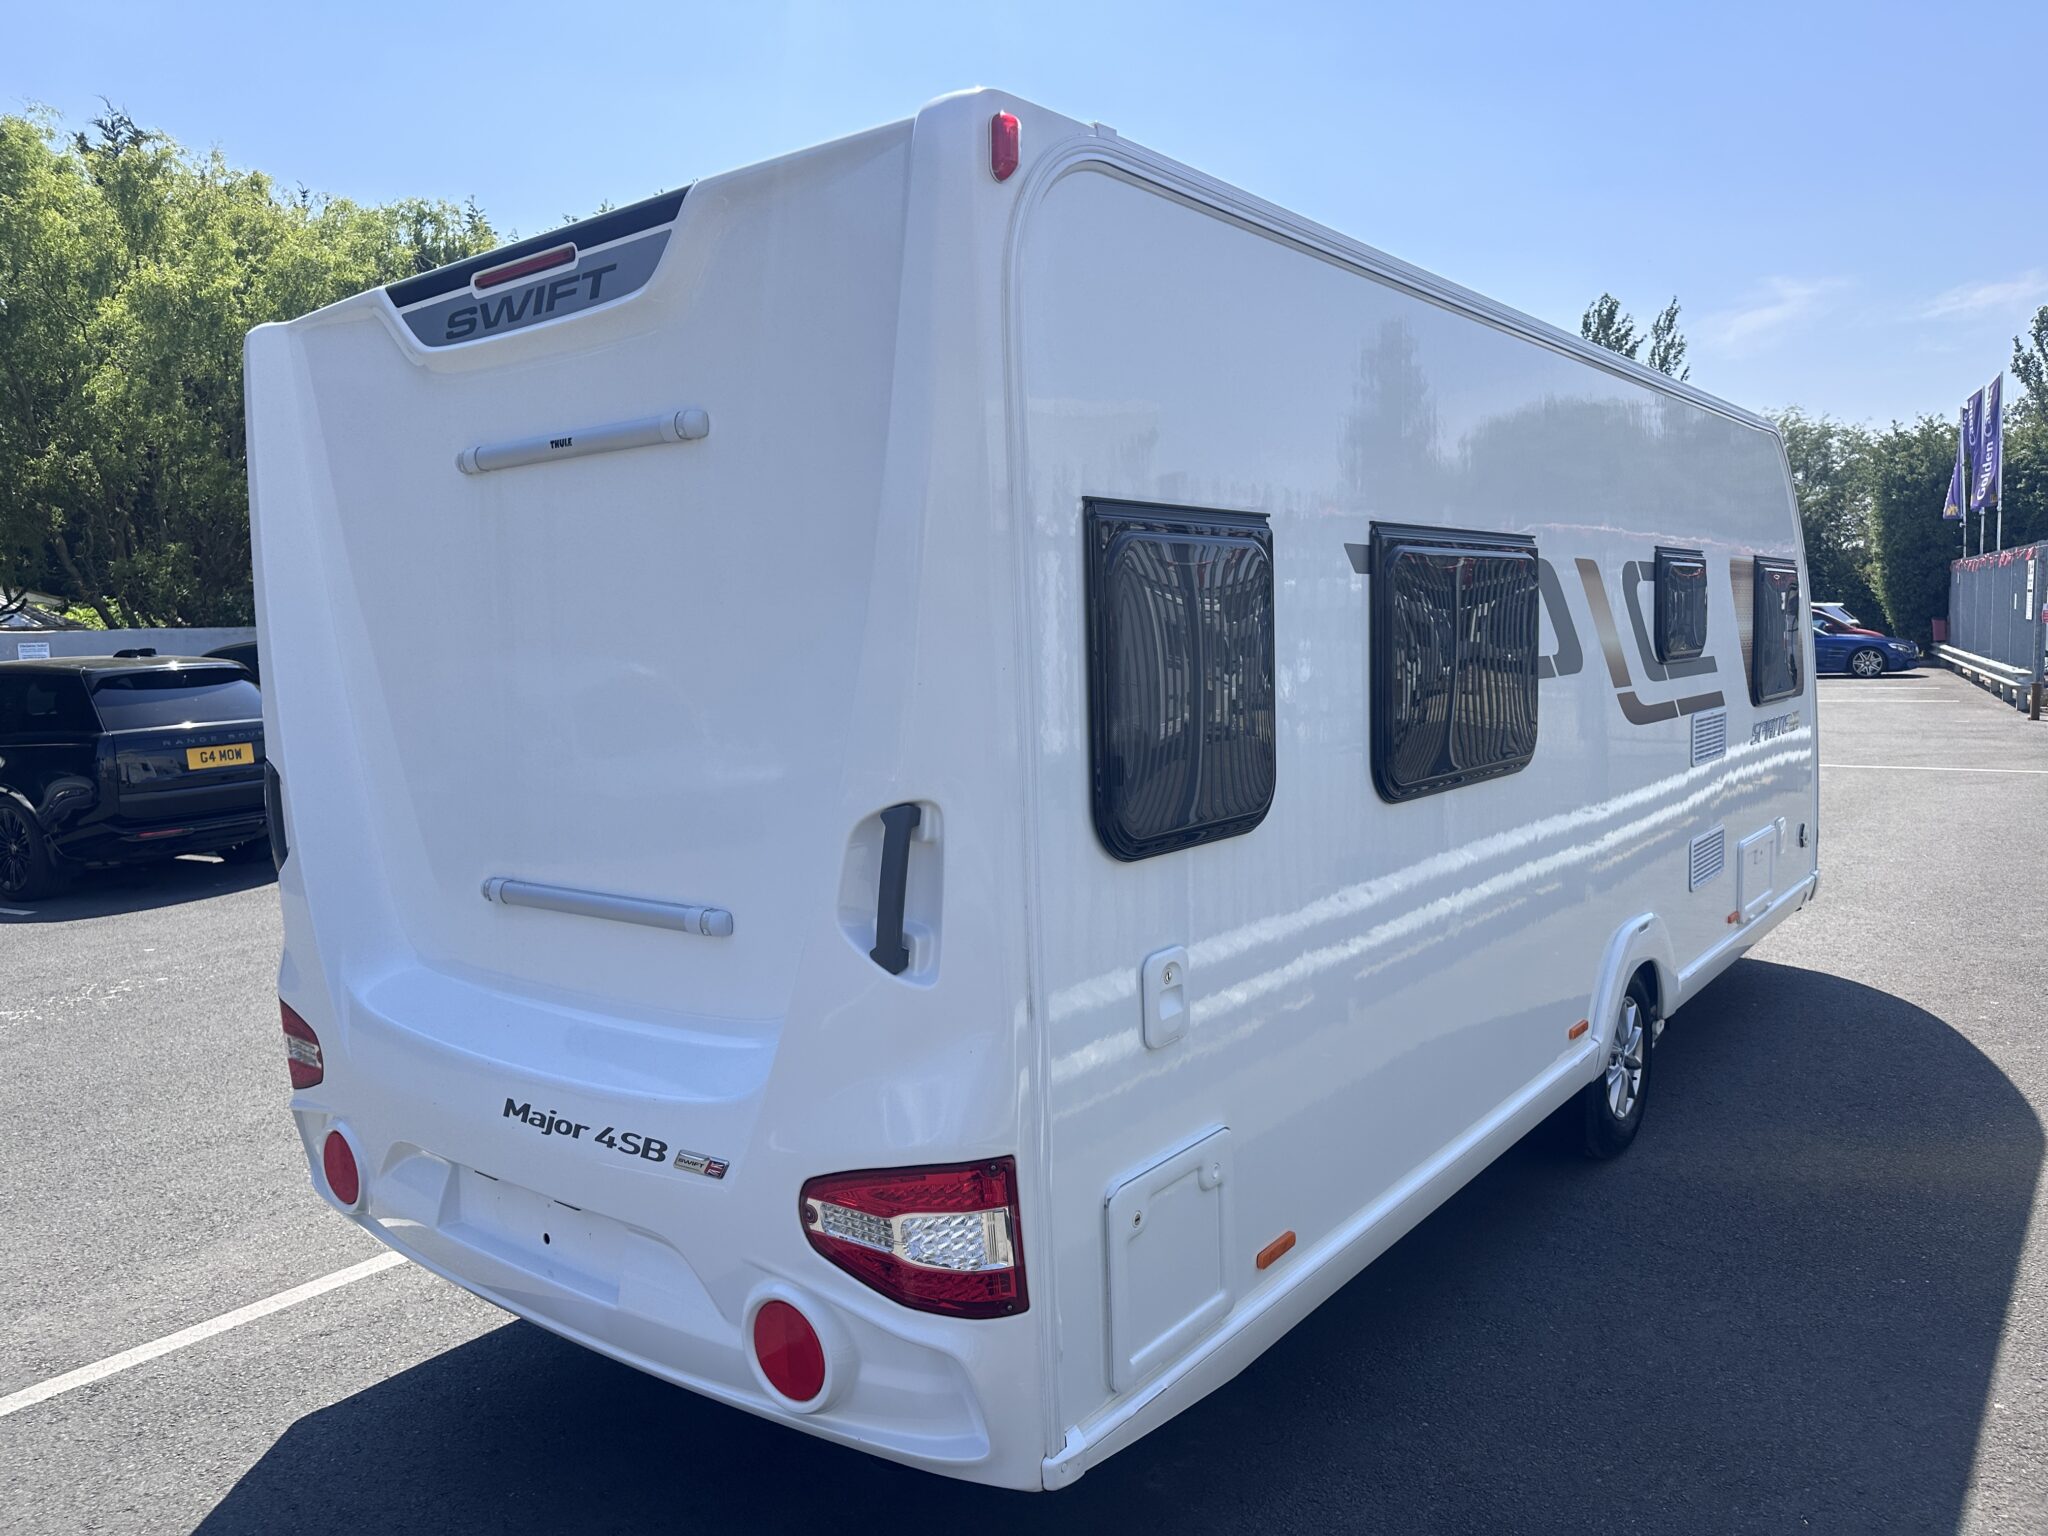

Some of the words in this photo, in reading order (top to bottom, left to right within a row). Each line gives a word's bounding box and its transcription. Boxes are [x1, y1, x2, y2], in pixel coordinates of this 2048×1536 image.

[445, 263, 617, 340] SWIFT
[550, 437, 573, 450] THULE
[1977, 441, 1993, 501] Golden
[163, 736, 217, 746] RANGE
[200, 751, 216, 763] G4
[219, 748, 242, 762] MOW
[503, 1097, 590, 1139] Major
[595, 1126, 668, 1162] 4SB
[677, 1157, 705, 1169] SWIFT
